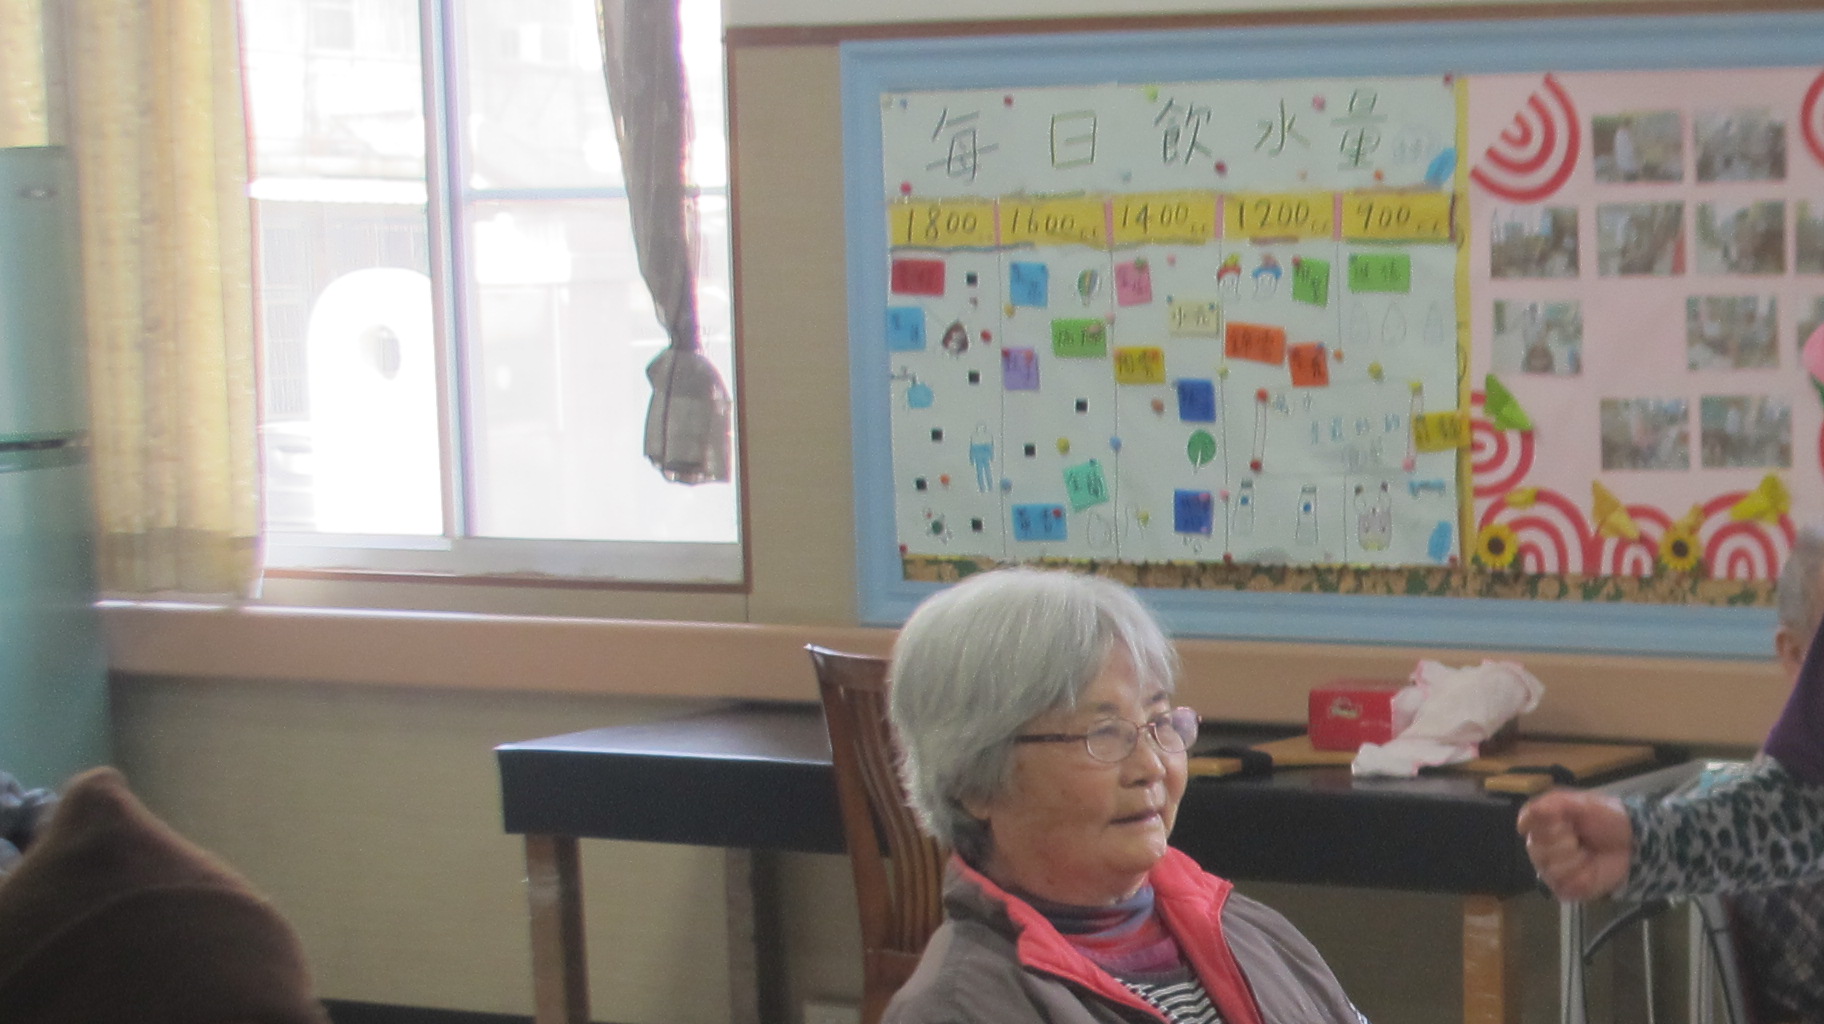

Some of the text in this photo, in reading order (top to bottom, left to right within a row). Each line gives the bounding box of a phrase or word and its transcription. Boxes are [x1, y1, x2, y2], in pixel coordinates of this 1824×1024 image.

[926, 88, 1388, 182] 每日飲水量
[908, 204, 978, 243] 1800
[1238, 198, 1310, 231] 1200
